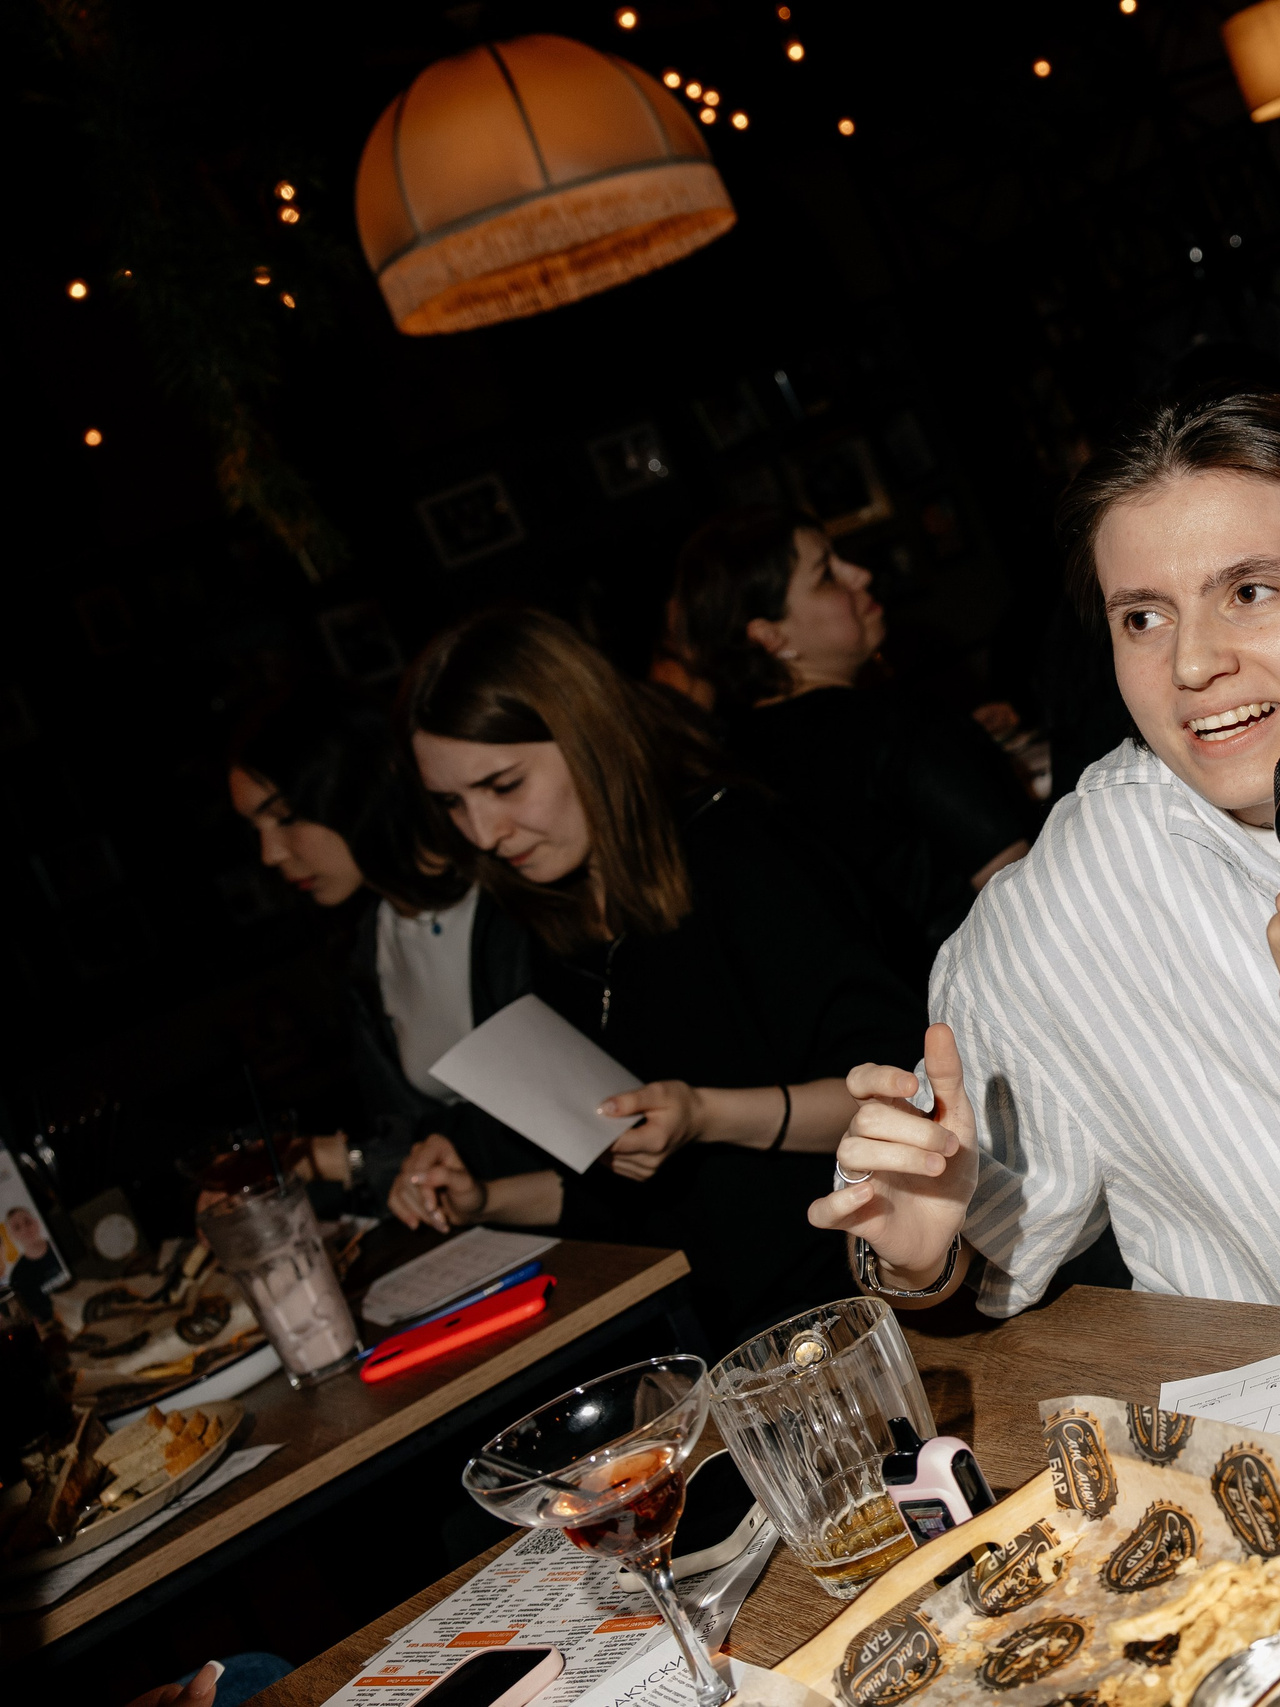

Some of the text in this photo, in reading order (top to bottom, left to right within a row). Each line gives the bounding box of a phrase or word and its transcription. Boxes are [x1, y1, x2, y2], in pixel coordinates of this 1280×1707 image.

[1048, 1458, 1069, 1495] БАР
[987, 1538, 1019, 1571] БАР
[1126, 1538, 1154, 1570] БАР
[858, 1629, 894, 1665] БАР
[605, 1655, 686, 1707] АКУСКИ
